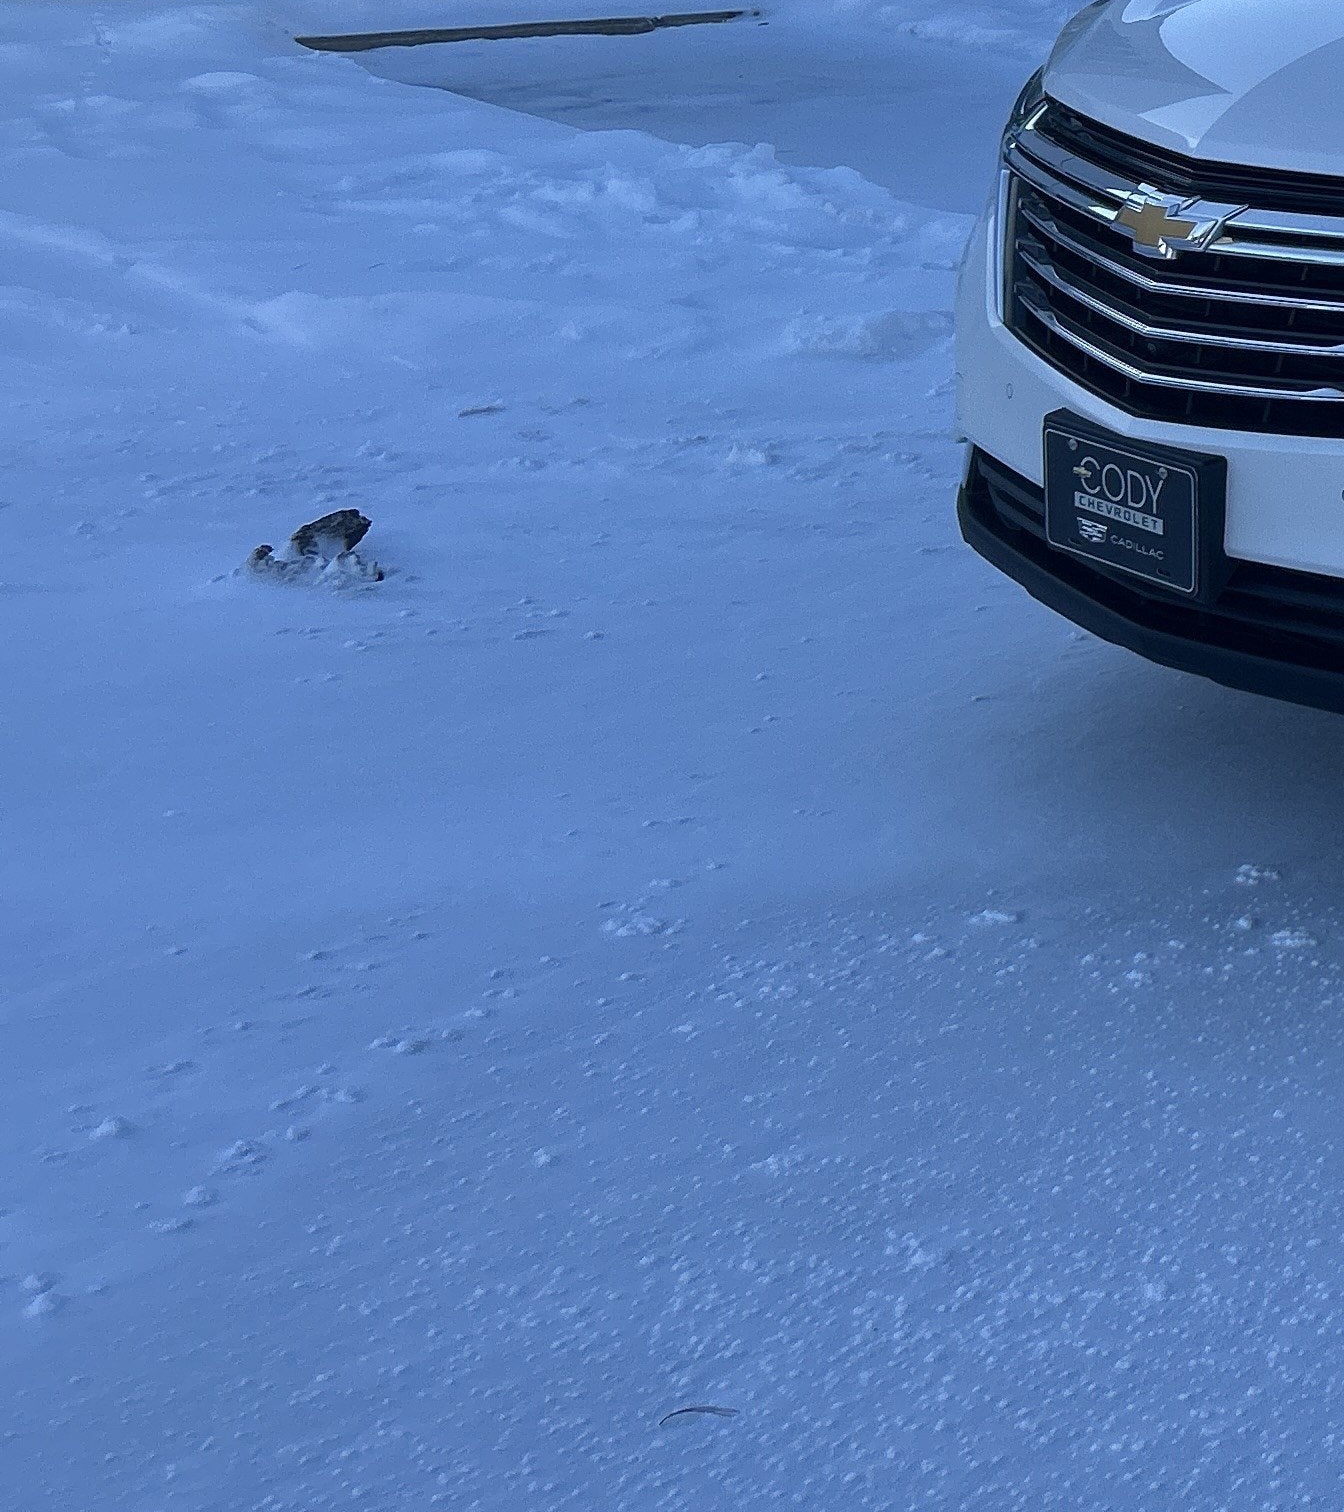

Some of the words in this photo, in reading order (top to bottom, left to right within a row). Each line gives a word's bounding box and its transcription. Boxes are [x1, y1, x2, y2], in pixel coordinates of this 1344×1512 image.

[1079, 456, 1164, 514] CODY
[1079, 494, 1159, 530] CHEVROLET
[1109, 534, 1165, 561] CADILLAC
